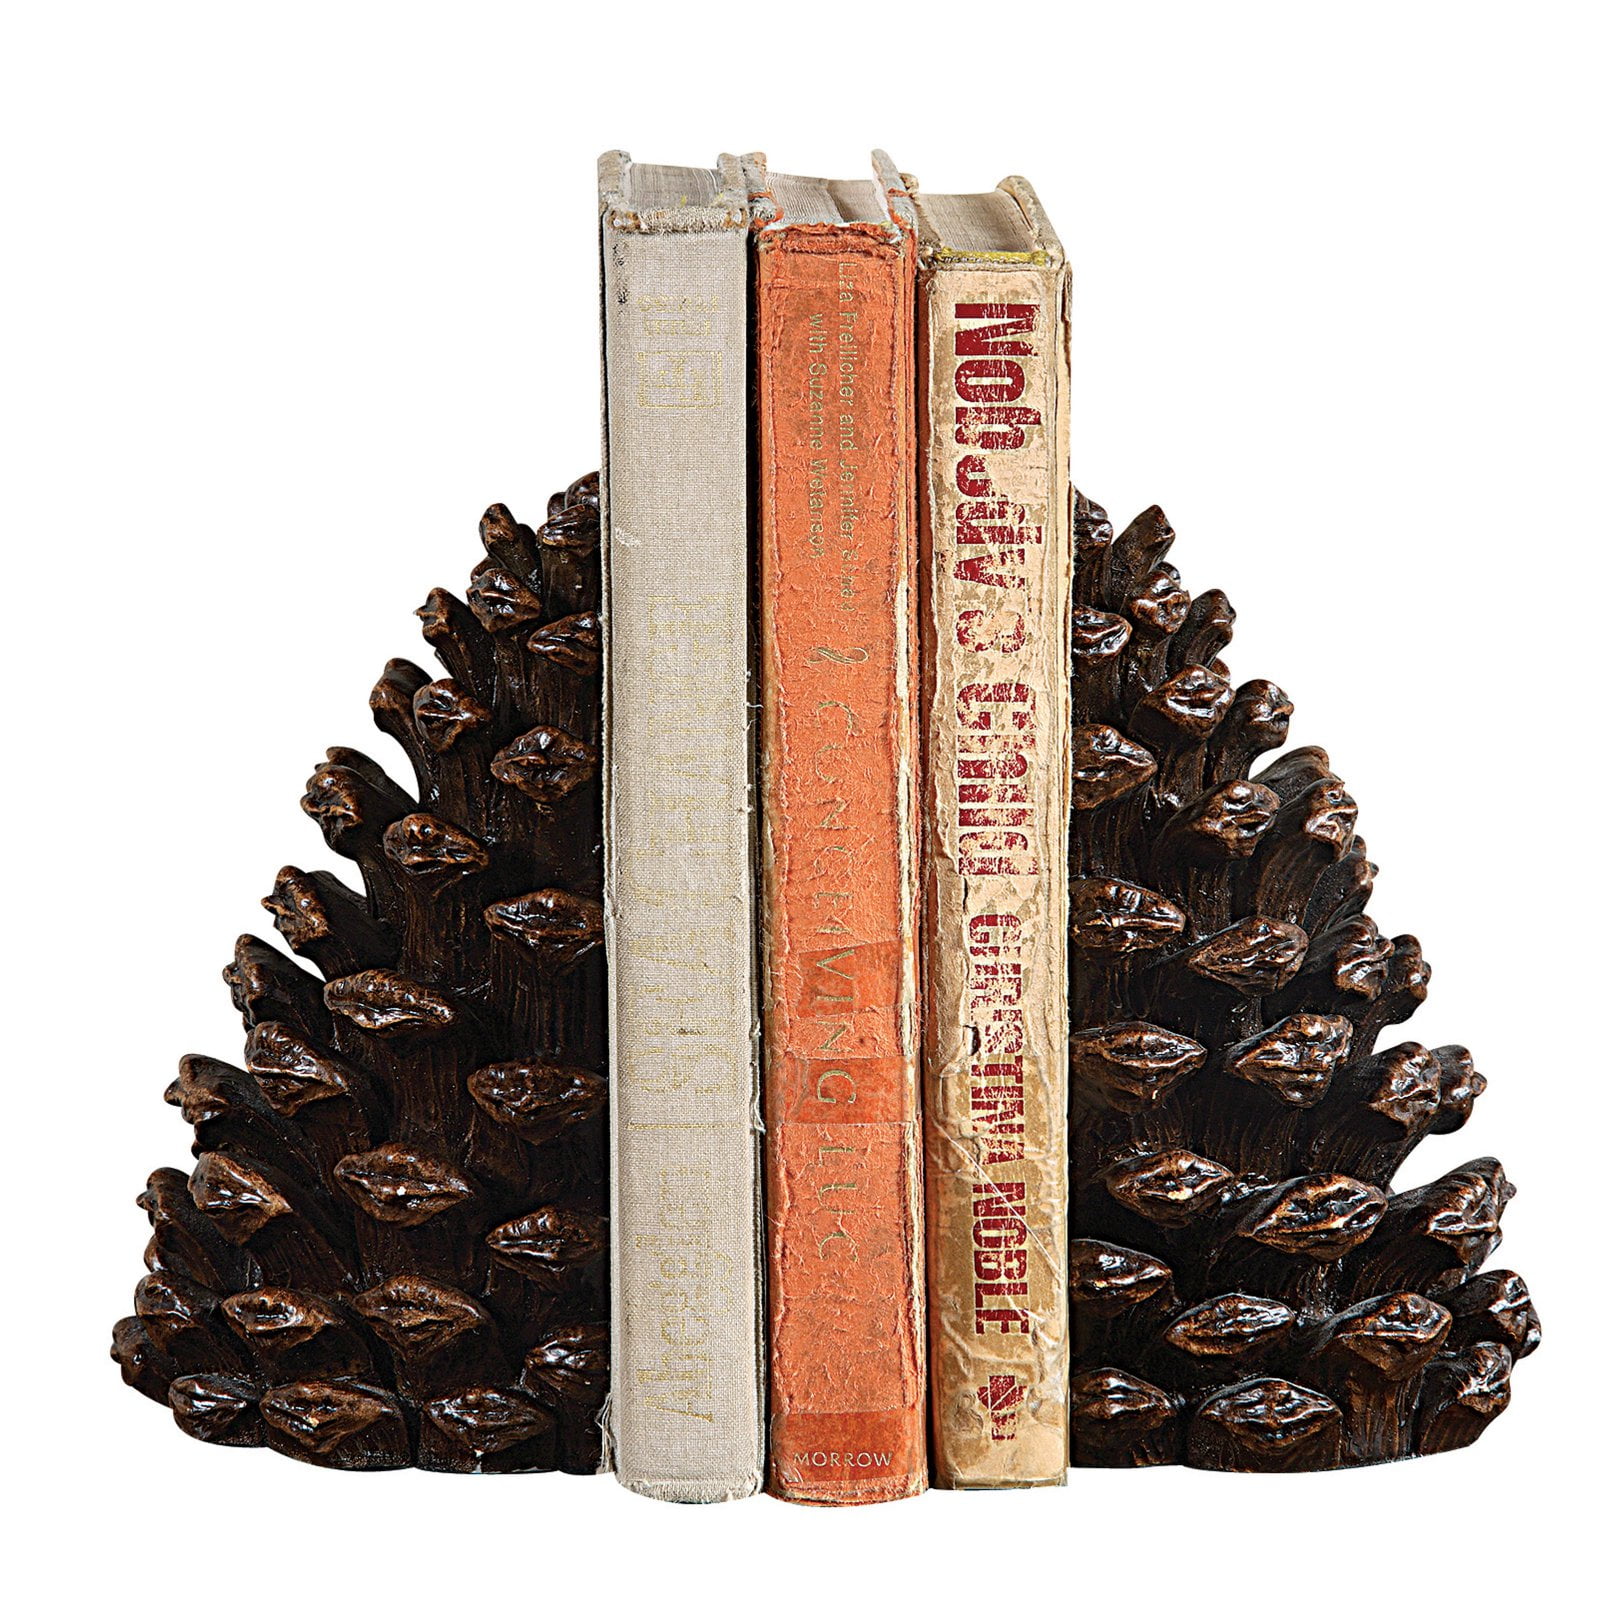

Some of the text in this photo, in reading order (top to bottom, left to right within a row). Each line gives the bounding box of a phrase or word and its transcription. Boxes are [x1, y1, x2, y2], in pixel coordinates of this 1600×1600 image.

[838, 262, 858, 303] Liza
[838, 311, 859, 407] Freilicher
[807, 313, 828, 560] with Suzanne Wetanson
[838, 413, 859, 451] and
[838, 457, 859, 541] Jennifer
[955, 682, 1038, 876] Child
[968, 913, 1031, 1335] CHRISTINA NOBLE
[792, 1451, 895, 1469] MORROW
